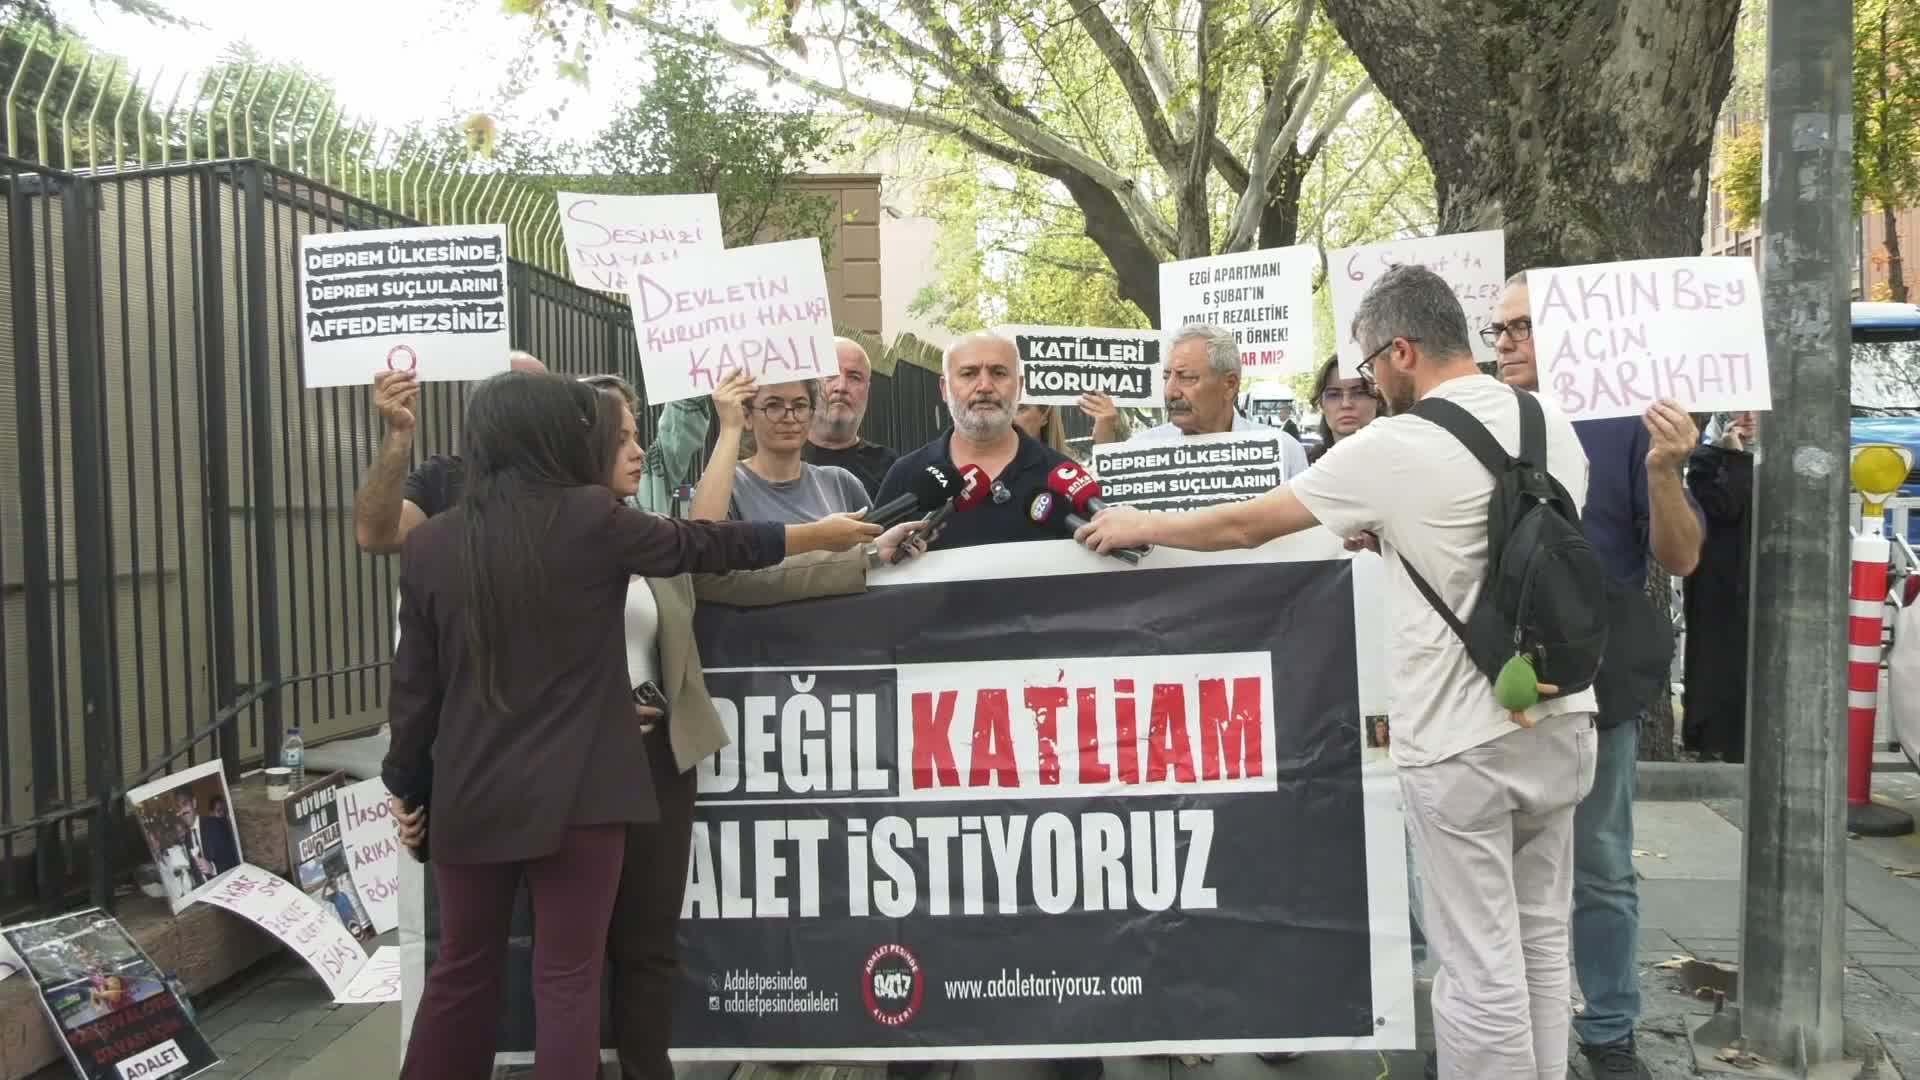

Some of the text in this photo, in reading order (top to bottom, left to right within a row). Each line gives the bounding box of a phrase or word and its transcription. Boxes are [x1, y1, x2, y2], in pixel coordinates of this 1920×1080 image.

[308, 242, 501, 270] DEPREM ÜLKESİNDE,
[1347, 252, 1364, 281] 6
[1189, 262, 1281, 286] EZGİ APARTMANI
[311, 278, 498, 301] DEPREM SUÇLULARINI
[1203, 286, 1264, 308] 6 ŞUBAT'IN
[1538, 271, 1661, 326] AKIN
[309, 306, 506, 338] AFFEDEMEZSİNİZ!
[1223, 304, 1289, 324] REZALETİNE
[1029, 337, 1145, 362] KATİLLERİ
[1246, 327, 1289, 344] ÖRNEK!
[688, 335, 821, 389] KAPALI
[1241, 350, 1285, 366] AR MI?
[1028, 371, 1144, 393] KORUMA!
[1552, 351, 1753, 414] BARİKATI
[1099, 444, 1280, 473] DEPREM ÜLKESİNDE,
[1101, 474, 1277, 497] DEPREM SUÇLULARINI
[911, 676, 1264, 790] KATLİAM
[679, 810, 1219, 920] ALET İSTİYORUZ
[724, 989, 839, 1017] adaletpesindeaileleri
[124, 1046, 181, 1080] ADALET
